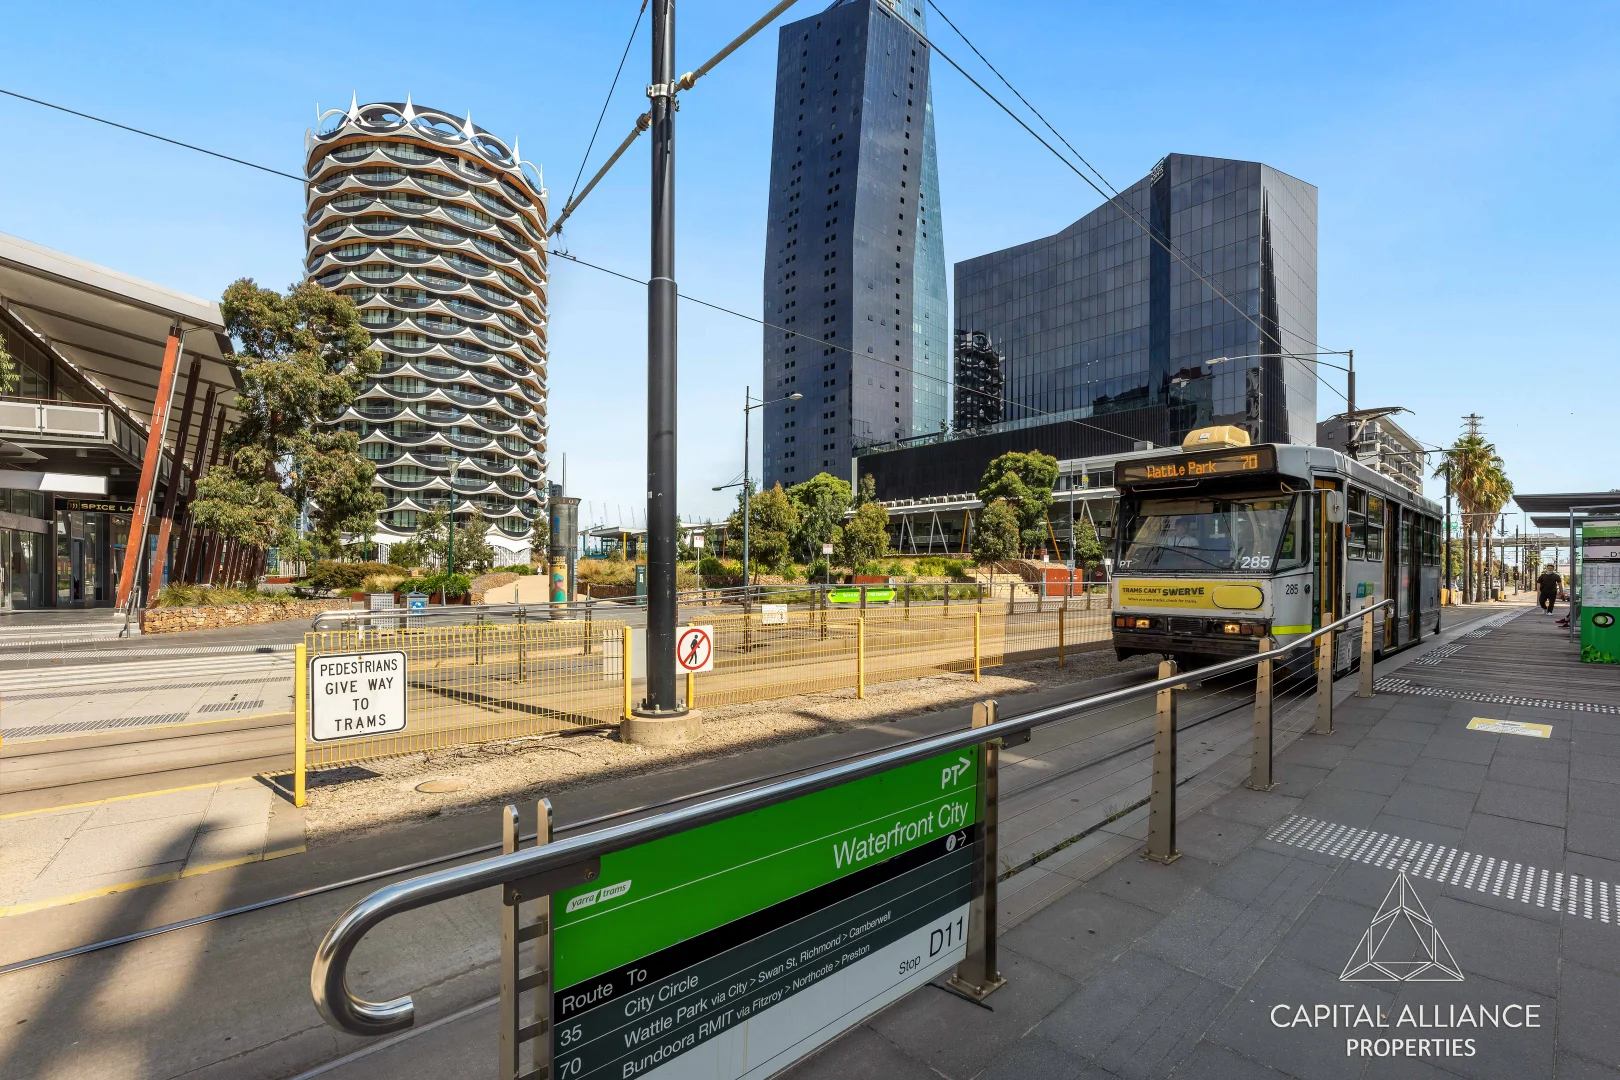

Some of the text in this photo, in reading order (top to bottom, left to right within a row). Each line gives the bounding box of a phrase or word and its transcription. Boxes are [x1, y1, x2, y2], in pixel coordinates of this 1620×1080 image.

[1146, 454, 1258, 479] Wattle Park 70
[81, 503, 116, 511] SPICE
[1240, 556, 1270, 569] 285
[1162, 587, 1205, 596] SWERVE
[1285, 584, 1299, 595] 285
[320, 659, 398, 677] PEDESTRIANS
[325, 677, 394, 695] GIVE WAY
[352, 697, 369, 711] TO
[335, 714, 386, 731] TRAMS
[833, 801, 969, 869] Waterfront City
[571, 884, 626, 909] yarra trams
[899, 916, 963, 975] Stop D11
[560, 910, 892, 1080] 70 Wattle Park via City Swan St, Richmond Camberwell
[562, 968, 647, 1014] Route To
[560, 975, 699, 1047] 35 City Circle
[622, 944, 870, 1080] Bundoora RMIT via Fitzroy Northcote Preston
